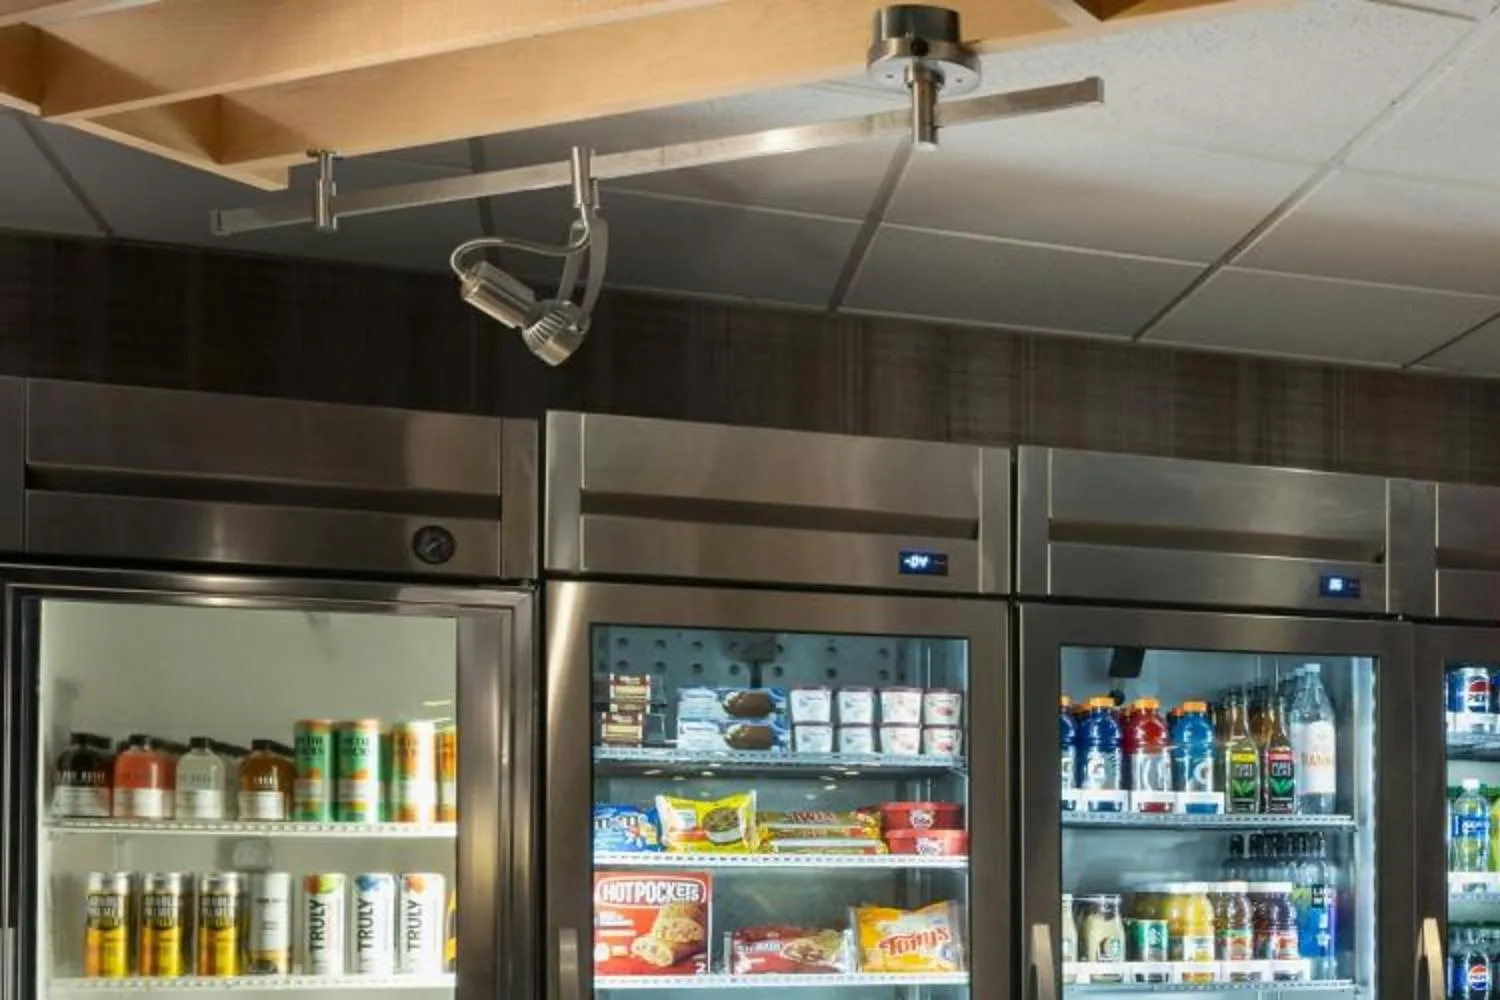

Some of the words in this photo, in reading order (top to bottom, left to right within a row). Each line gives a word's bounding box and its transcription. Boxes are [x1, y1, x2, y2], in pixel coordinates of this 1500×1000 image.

[308, 900, 326, 952] TRULY
[357, 898, 374, 952] TRULY
[407, 900, 424, 952] TRULY
